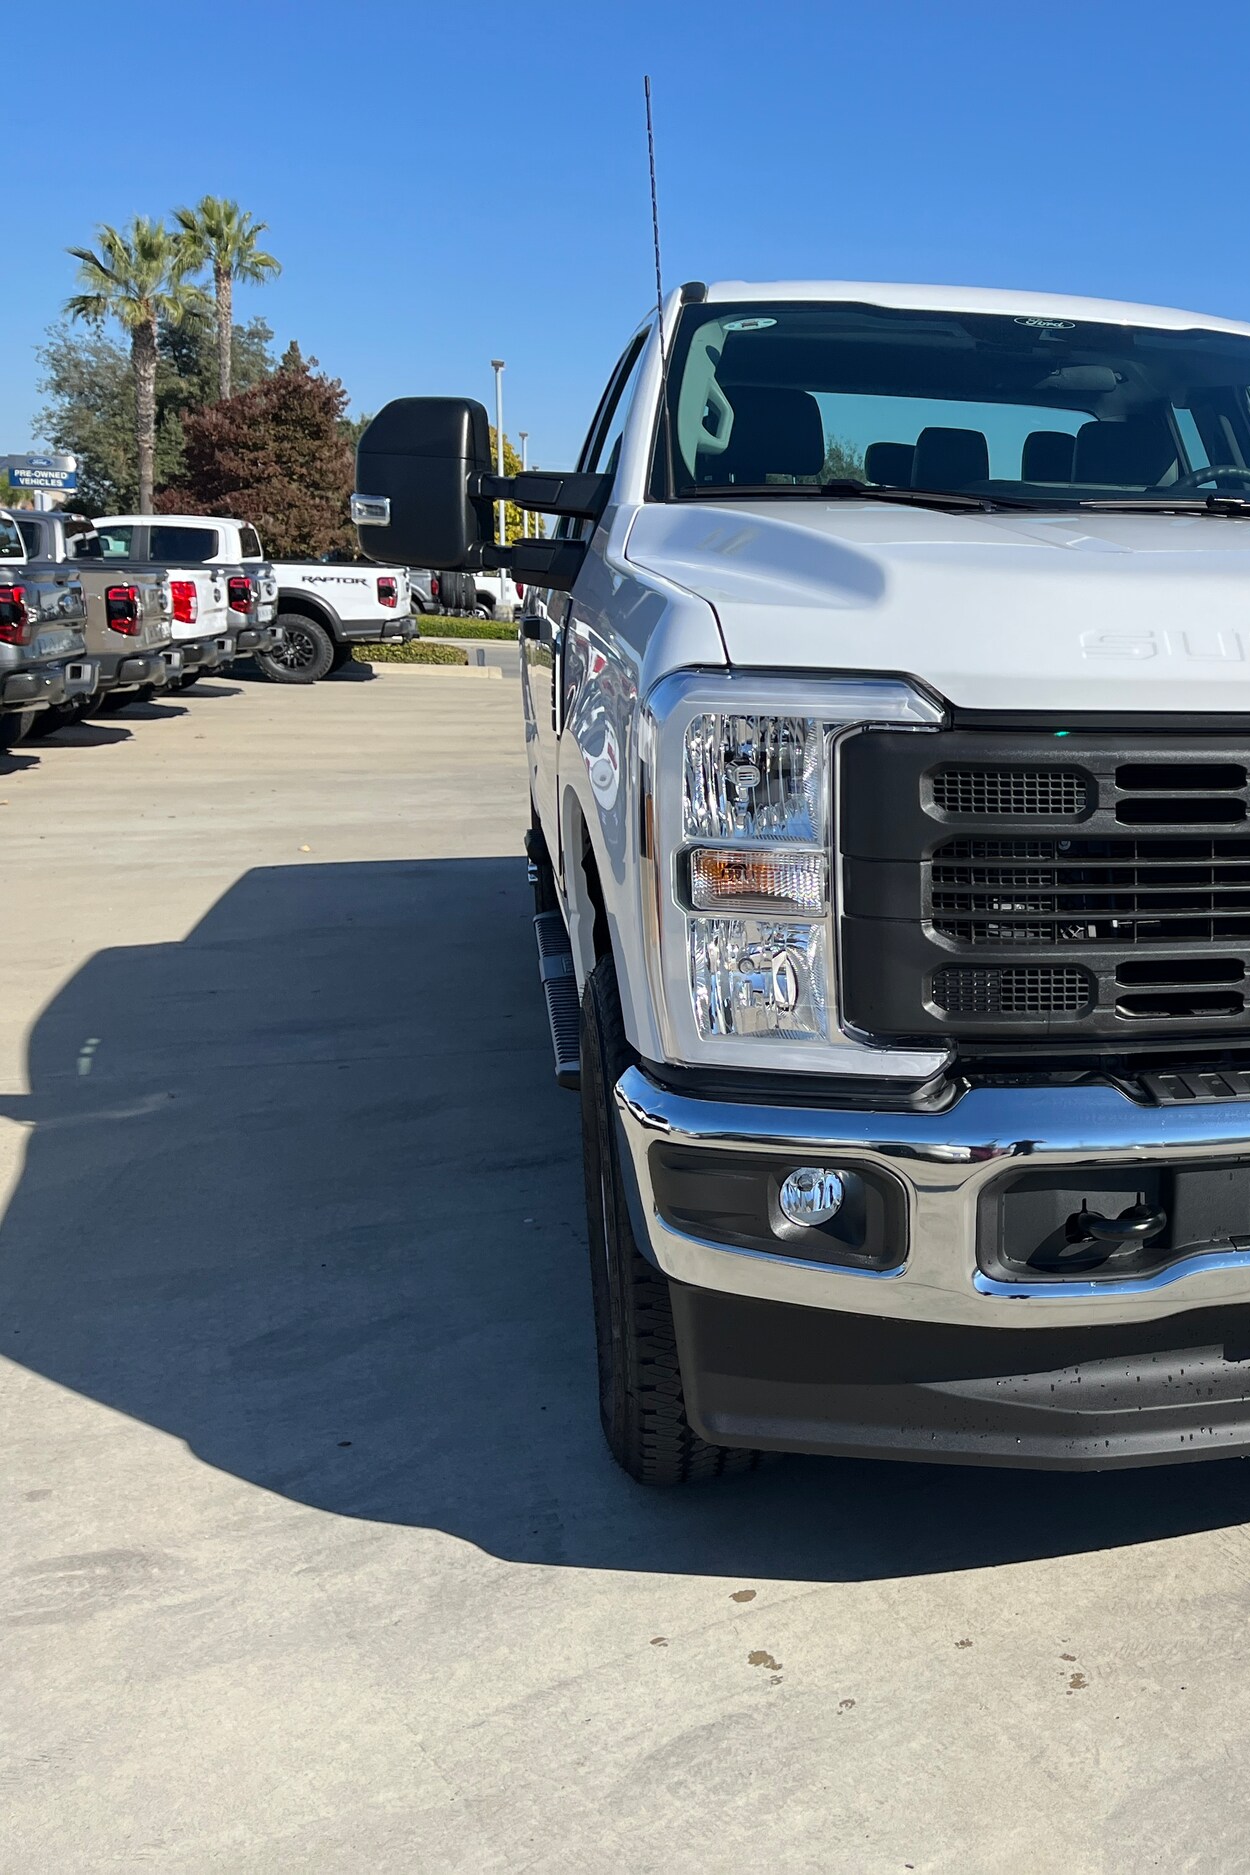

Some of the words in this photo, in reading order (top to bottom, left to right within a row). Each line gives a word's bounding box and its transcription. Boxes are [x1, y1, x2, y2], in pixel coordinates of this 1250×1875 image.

[1025, 318, 1065, 327] Ford
[14, 469, 69, 480] PRE-OWNED
[19, 477, 64, 487] VEHICLES
[301, 575, 370, 588] RAPTOR
